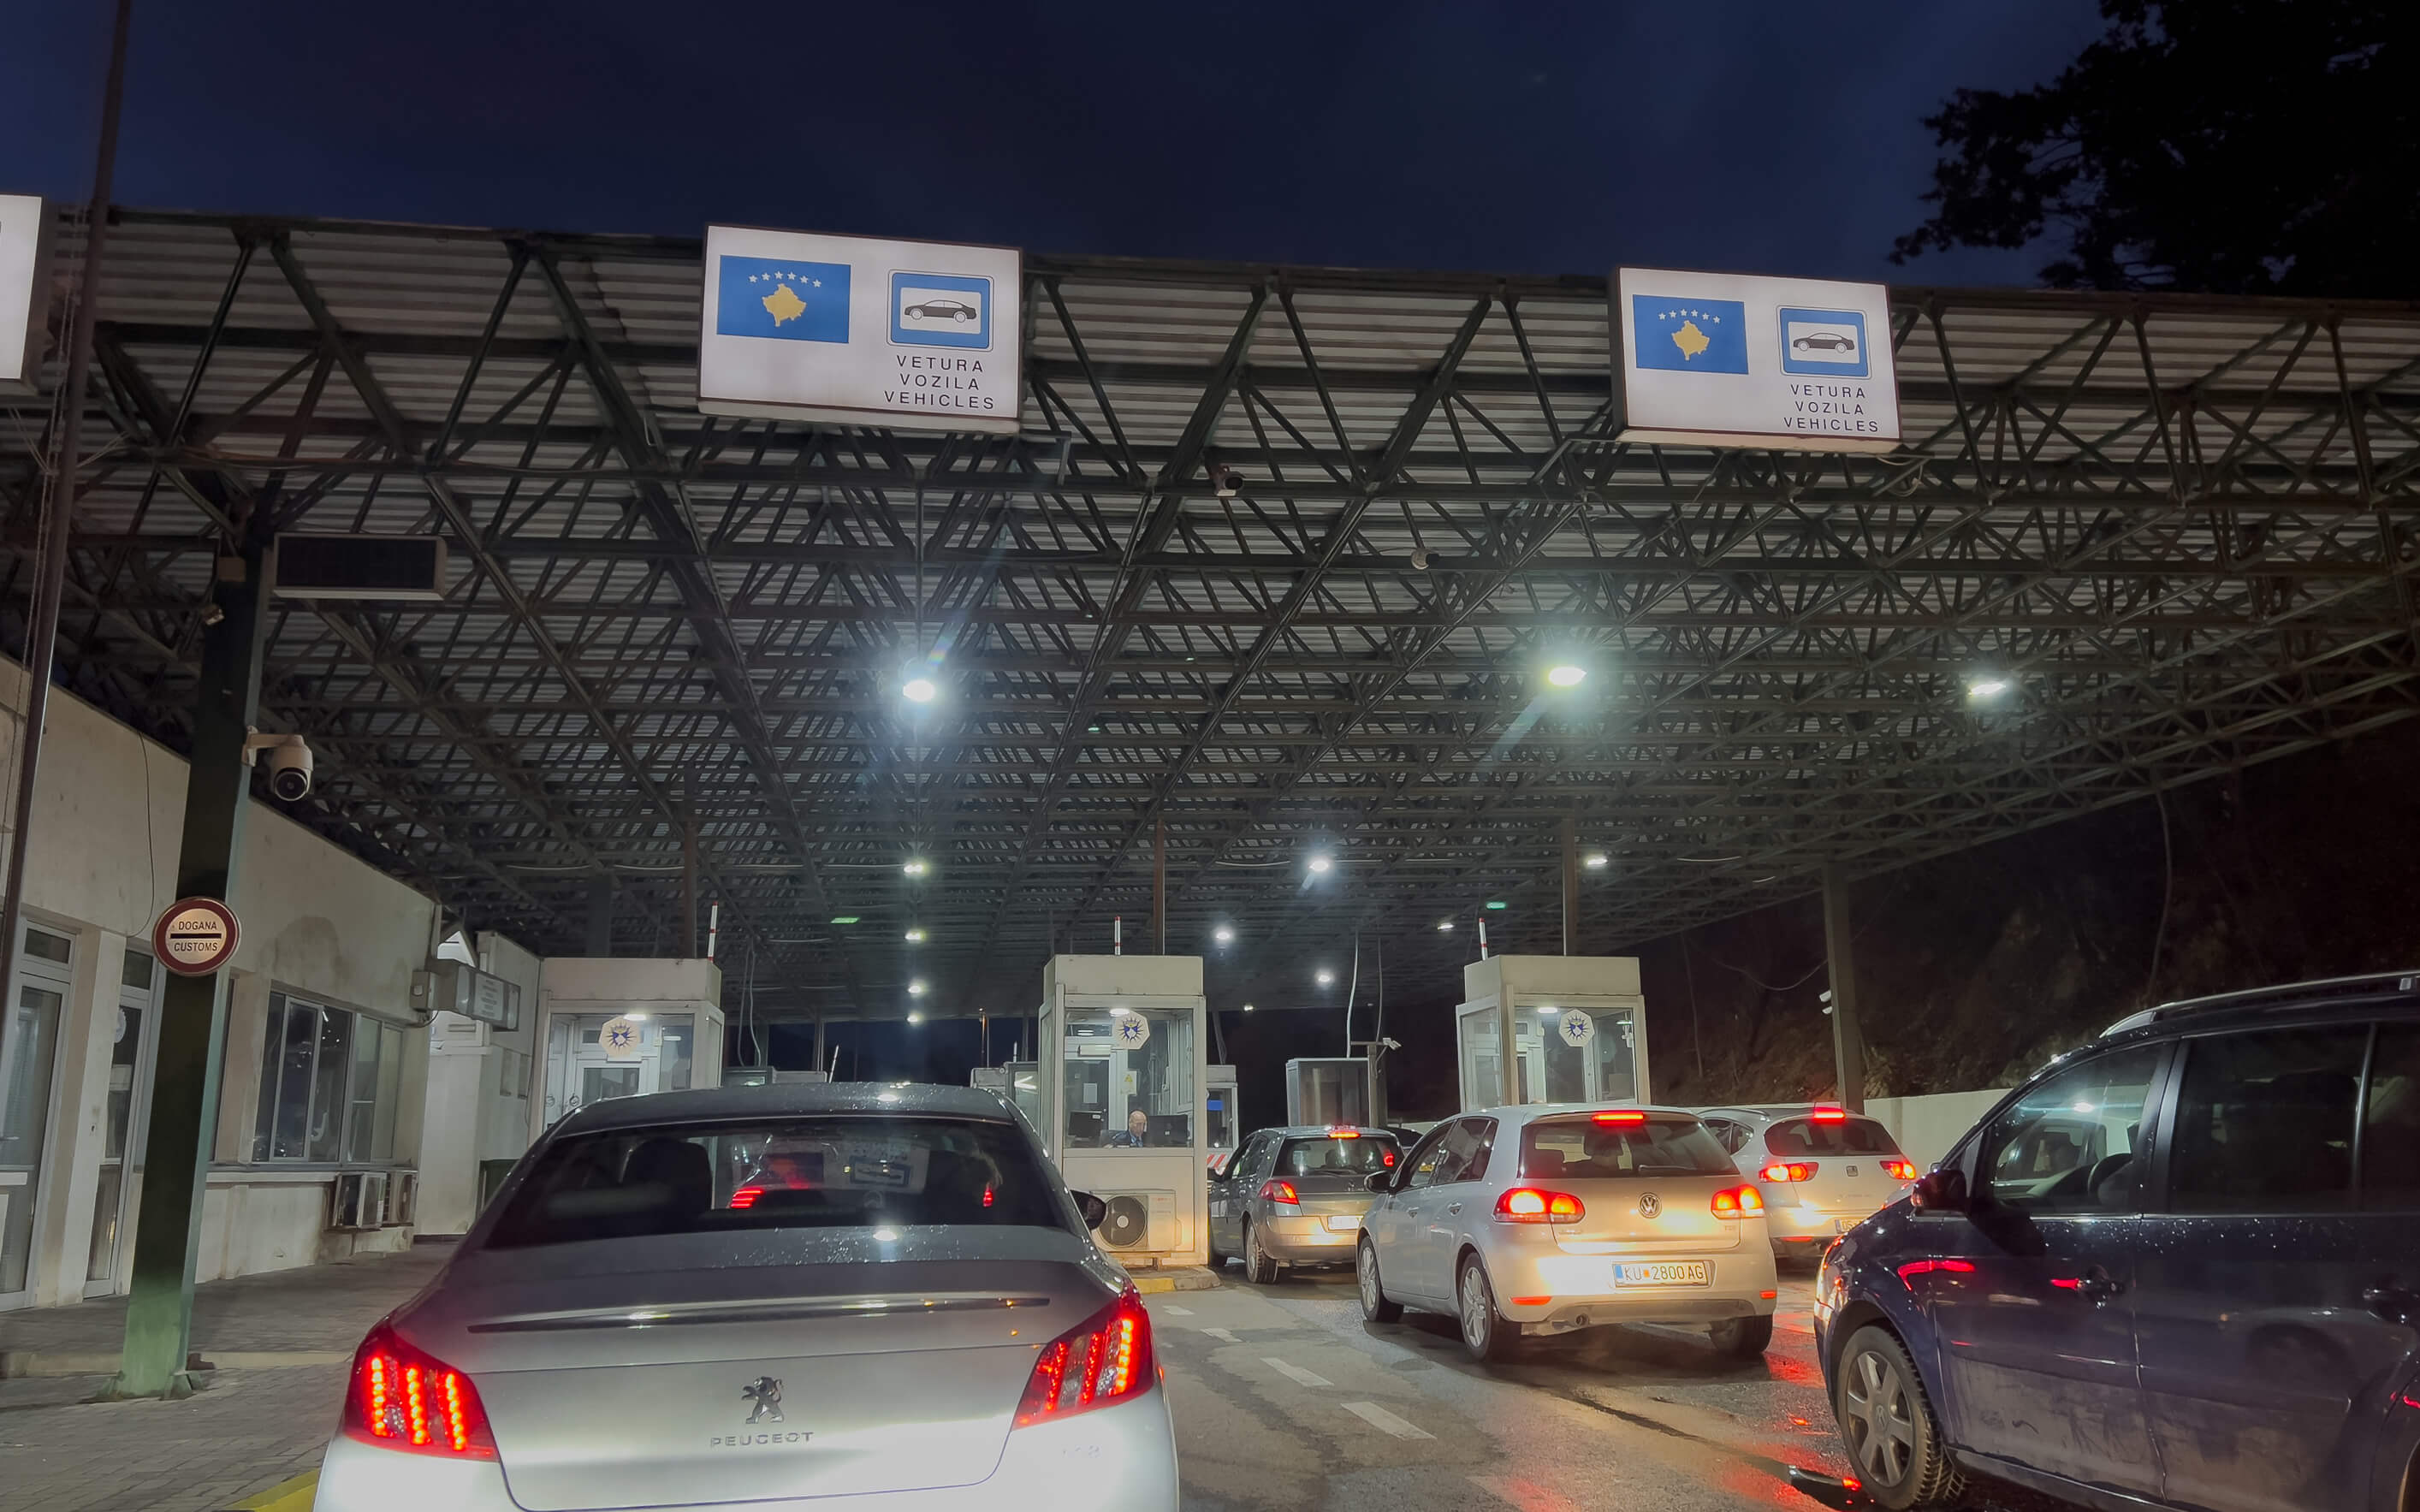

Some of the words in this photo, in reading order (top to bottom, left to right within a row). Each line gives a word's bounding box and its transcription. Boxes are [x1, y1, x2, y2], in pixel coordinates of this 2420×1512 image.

[896, 354, 983, 373] VETURA
[899, 372, 980, 391] VOZILA
[1790, 384, 1866, 399] VETURA
[883, 390, 994, 410] VEHICLES
[1794, 400, 1864, 416] VOZILA
[1783, 417, 1879, 433] VEHICLES
[178, 921, 217, 931] DOGANA
[174, 942, 218, 952] CUSTOMS
[1624, 1266, 1641, 1281] KU
[1651, 1266, 1685, 1281] 2800
[1687, 1266, 1704, 1280] AG
[710, 1432, 814, 1448] PEUGEOT
